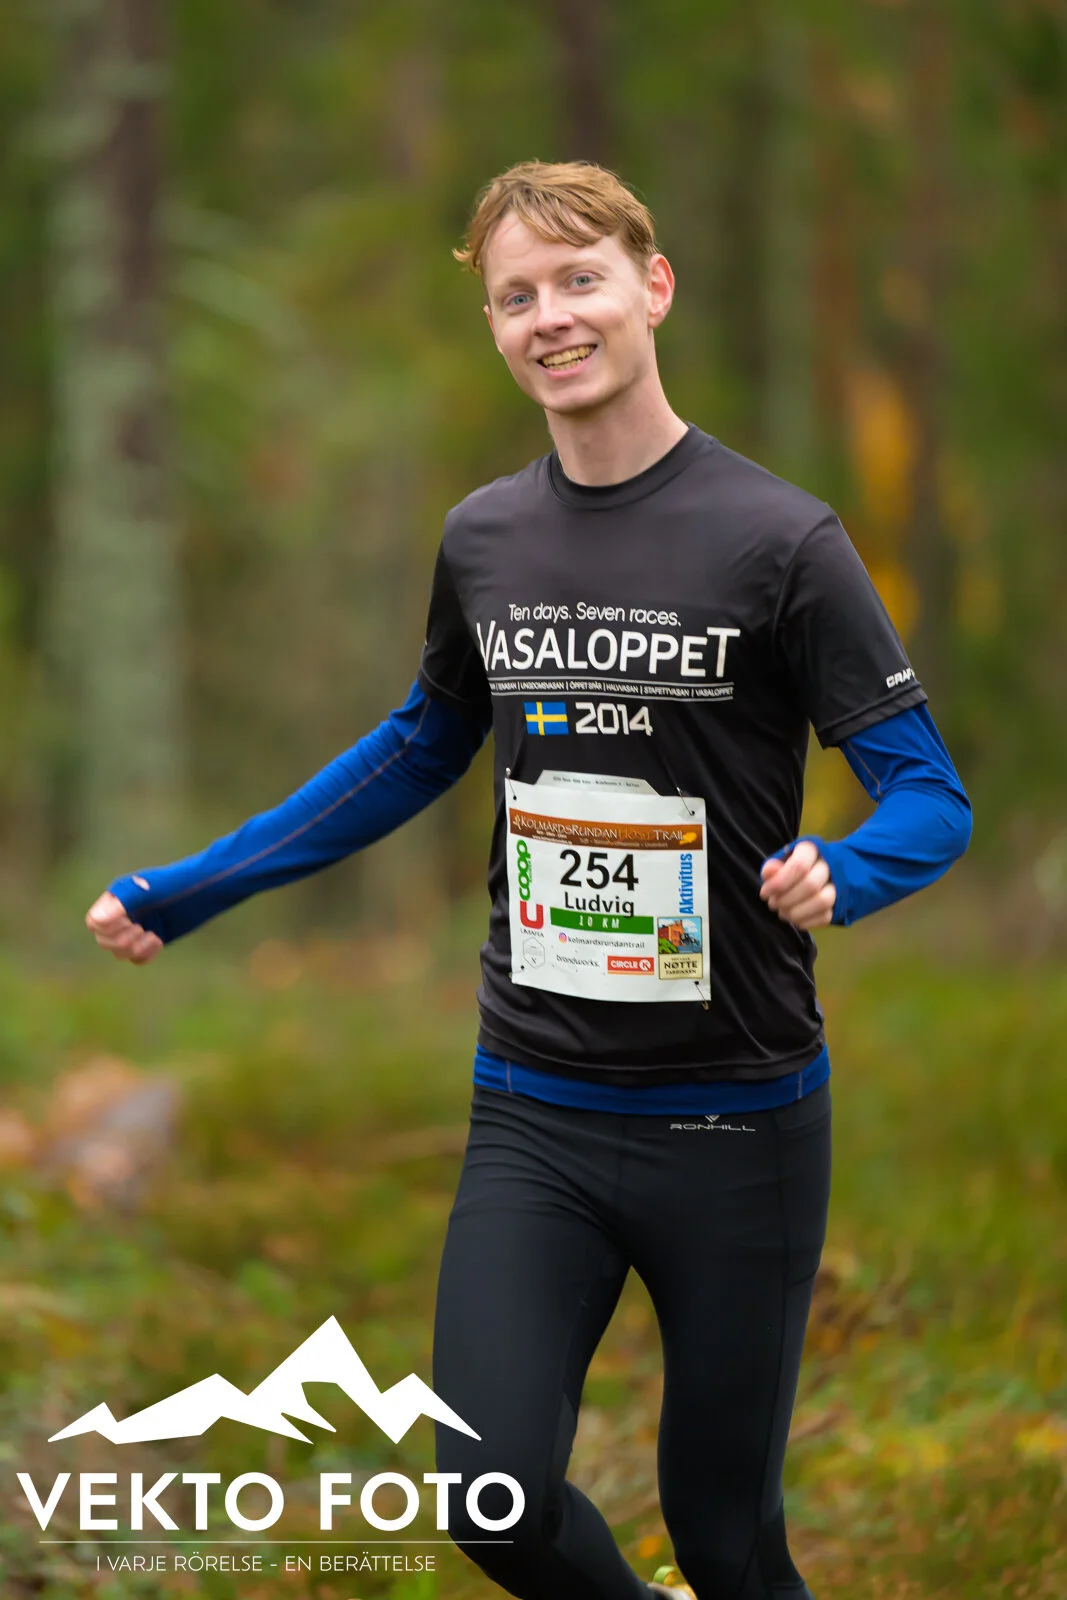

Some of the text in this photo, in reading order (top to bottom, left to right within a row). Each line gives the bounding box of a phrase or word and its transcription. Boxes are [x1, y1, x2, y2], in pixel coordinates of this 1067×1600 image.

[509, 602, 682, 627] Ten days. Seven races.
[476, 620, 741, 678] VASALOPPET
[695, 686, 734, 698] VASALOPPET
[575, 701, 653, 736] 2014
[516, 839, 531, 901] coop
[559, 849, 639, 891] 254
[678, 852, 695, 916] Aktivitus
[564, 891, 635, 919] Ludvig
[578, 916, 621, 930] 10 KM
[610, 960, 639, 969] CIRCLE
[669, 1123, 757, 1132] RONHILL
